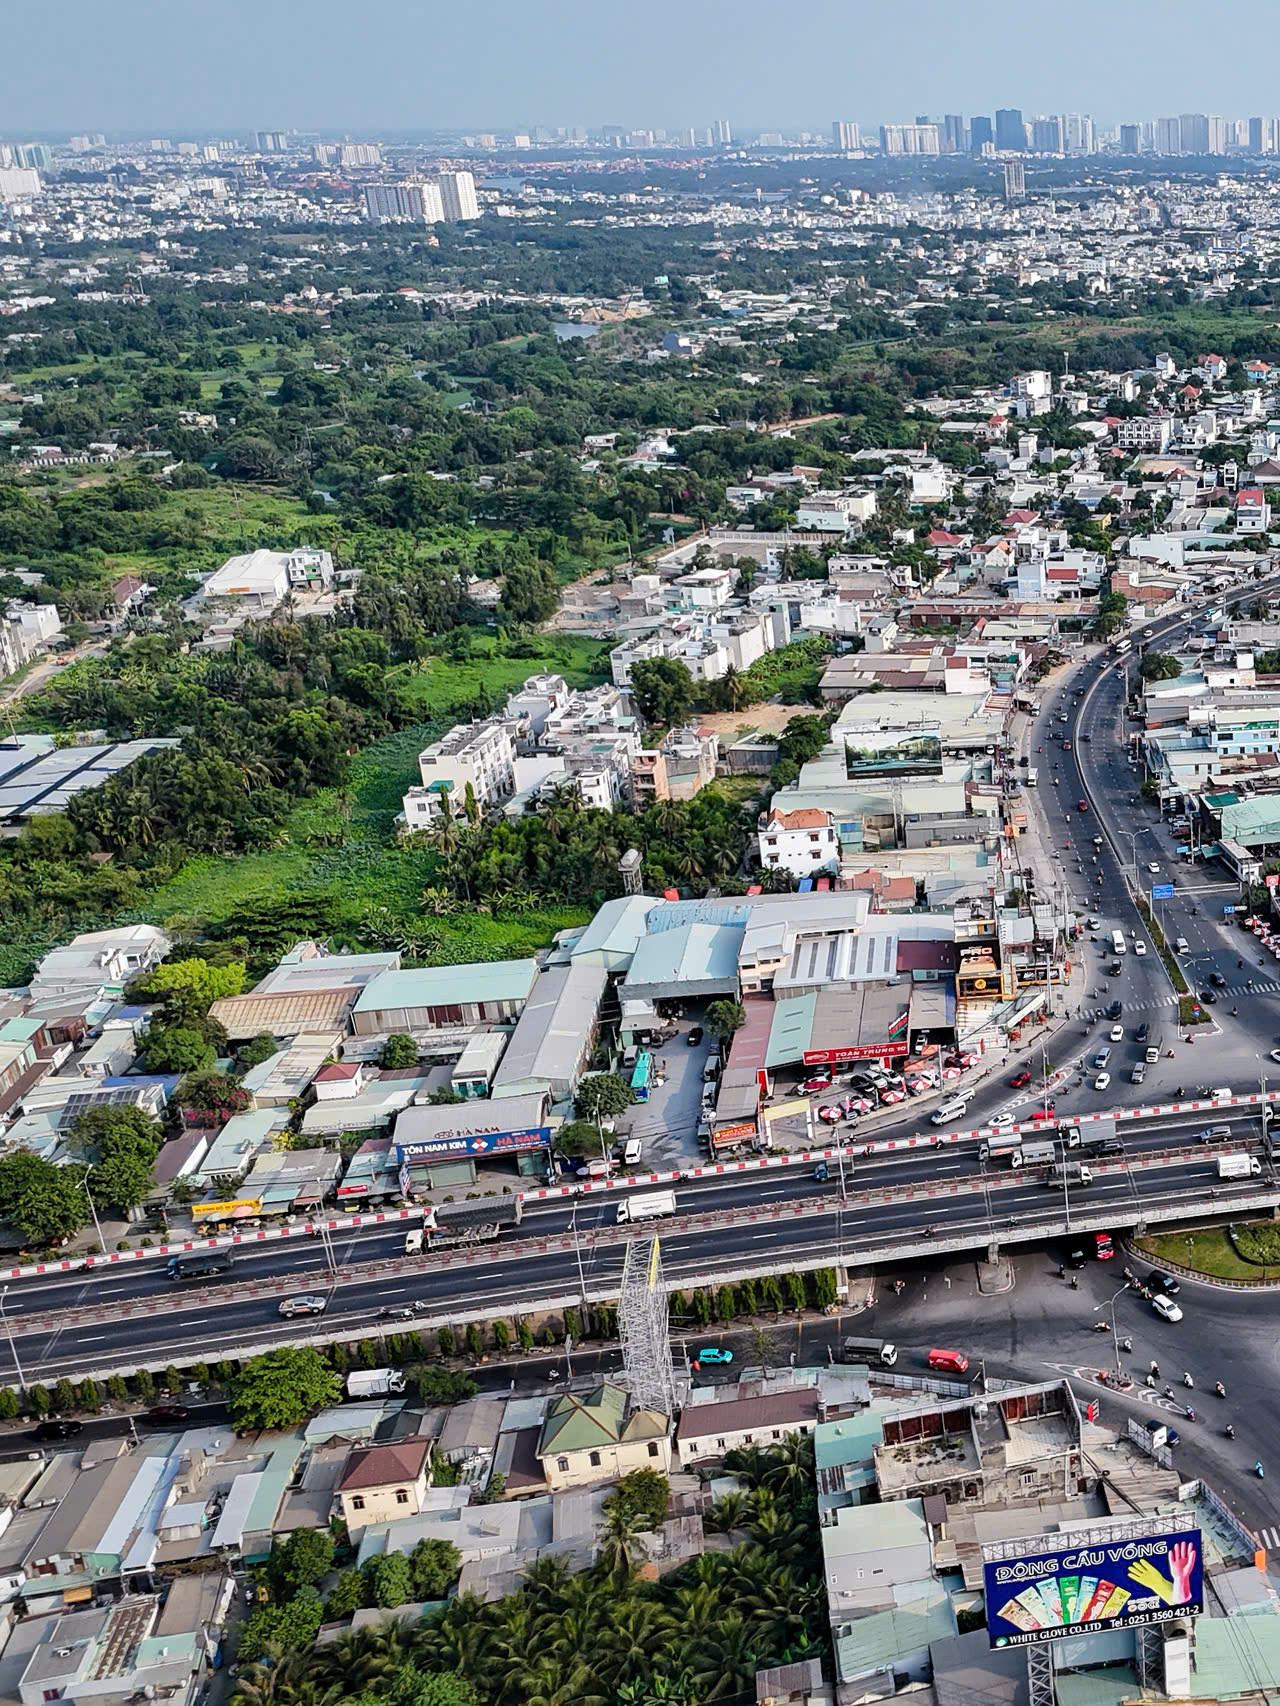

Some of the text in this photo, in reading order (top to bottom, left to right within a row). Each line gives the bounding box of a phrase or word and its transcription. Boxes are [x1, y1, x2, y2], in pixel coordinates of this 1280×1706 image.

[960, 947, 993, 956] PRO
[863, 1046, 894, 1055] TRUNG
[496, 1133, 541, 1146] HÀ NAM
[402, 1145, 424, 1155] TÔN
[424, 1143, 447, 1153] NAM
[449, 1140, 467, 1151] KIM
[1129, 1614, 1150, 1625] 0251
[1152, 1610, 1173, 1621] 3560
[1175, 1605, 1200, 1617] 421-2
[1008, 1633, 1038, 1644] WHITE
[1040, 1628, 1068, 1640] GLOVE
